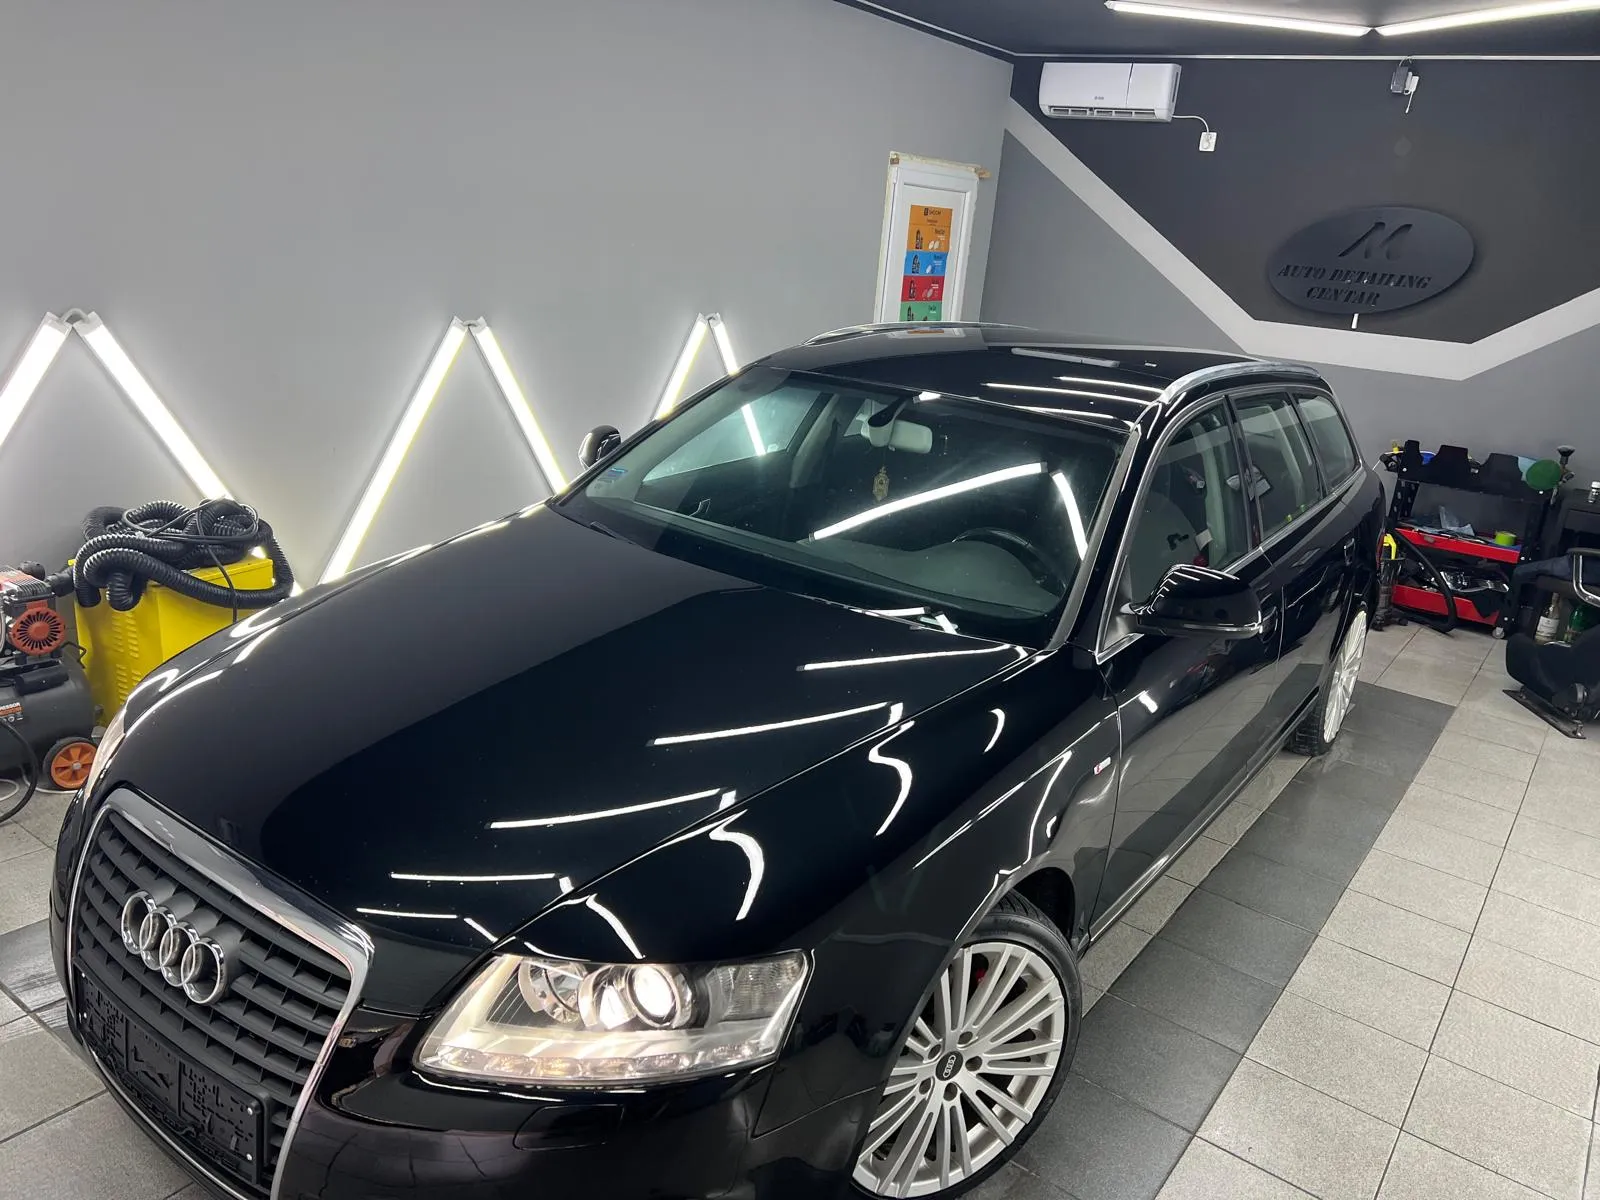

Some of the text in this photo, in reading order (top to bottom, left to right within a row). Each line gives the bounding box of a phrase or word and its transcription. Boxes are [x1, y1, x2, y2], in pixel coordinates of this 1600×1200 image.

[1278, 264, 1432, 289] AUTO DETAILING
[1306, 286, 1381, 306] CENTAR
